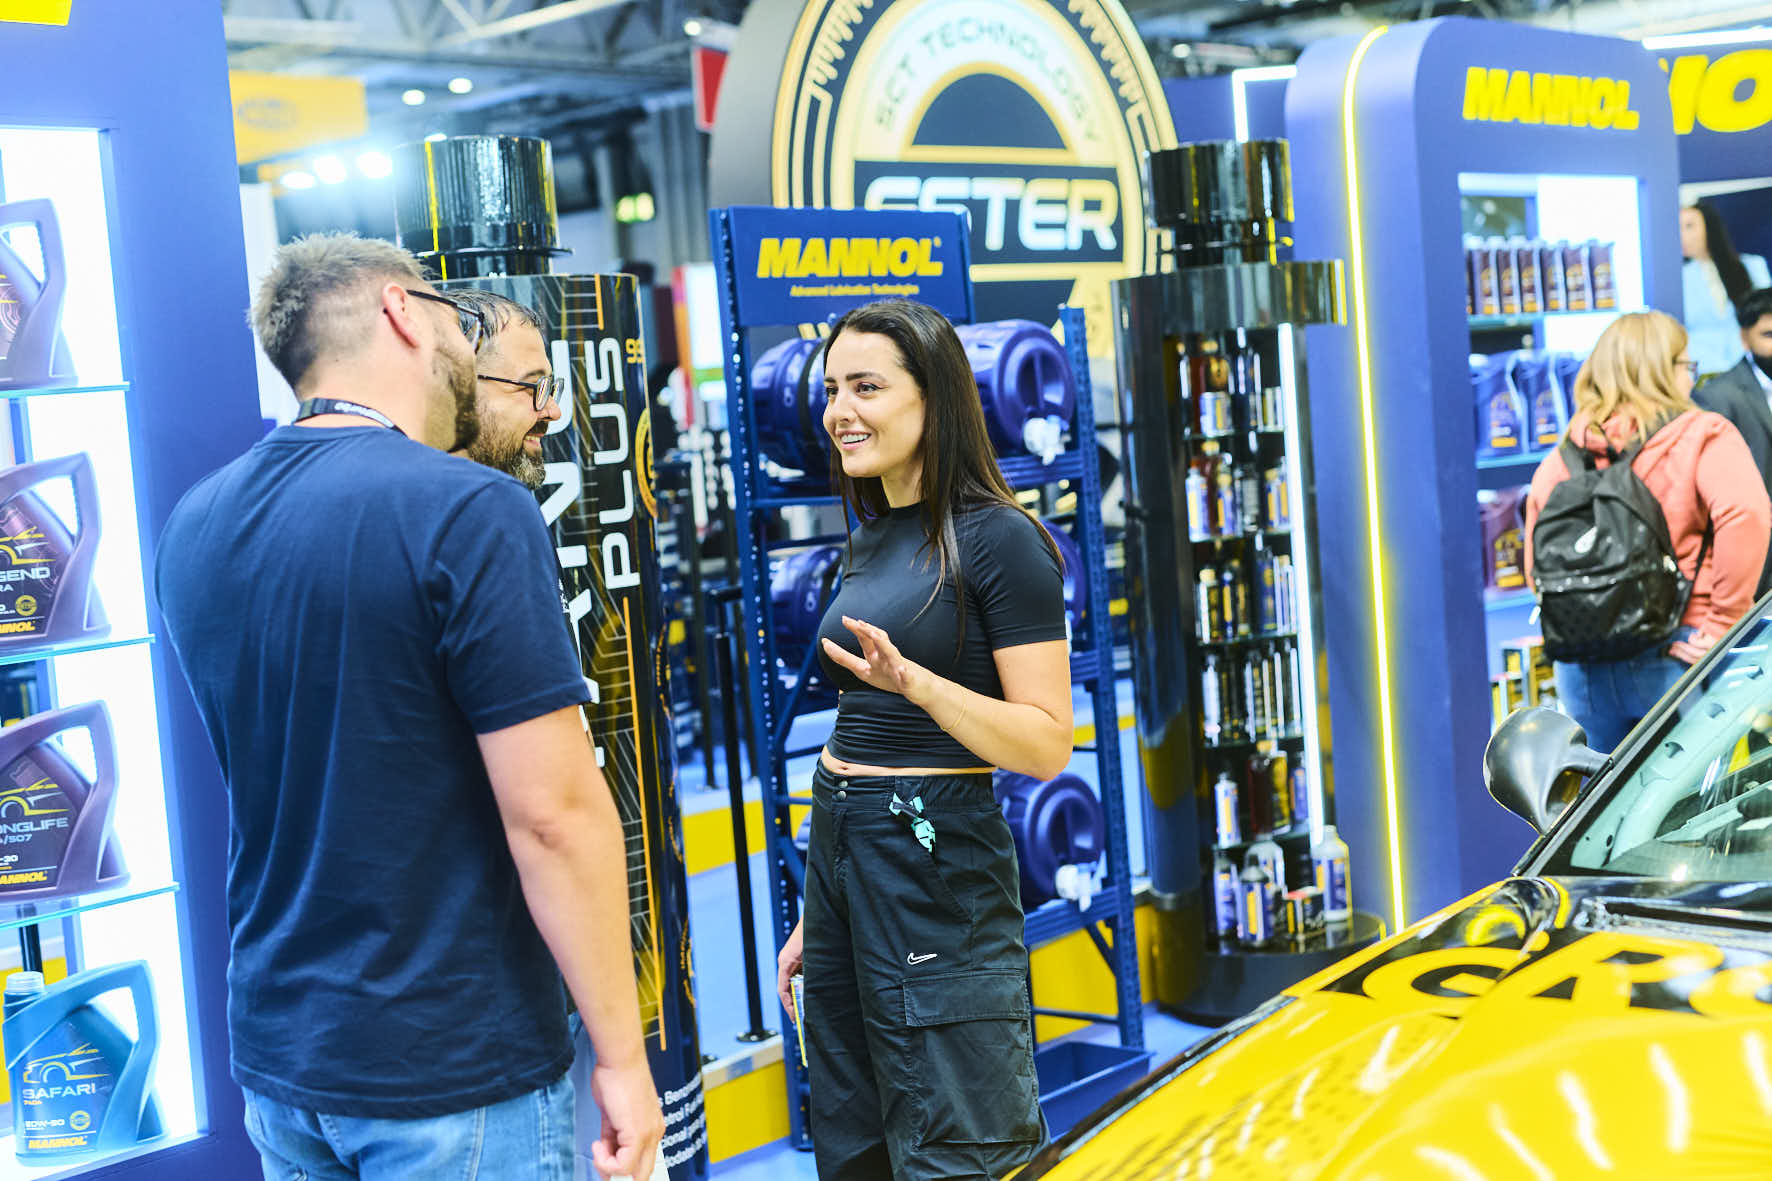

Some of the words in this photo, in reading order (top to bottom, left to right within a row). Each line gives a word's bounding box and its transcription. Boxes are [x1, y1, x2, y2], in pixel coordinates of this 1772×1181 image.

[919, 16, 1102, 141] TECHNOLOGY
[1462, 66, 1640, 130] MANNOL
[757, 237, 943, 279] MANNOL
[585, 337, 641, 590] PLUS
[0, 817, 69, 834] NGLIFE
[0, 834, 33, 845] /507
[22, 1083, 96, 1100] SAFARI
